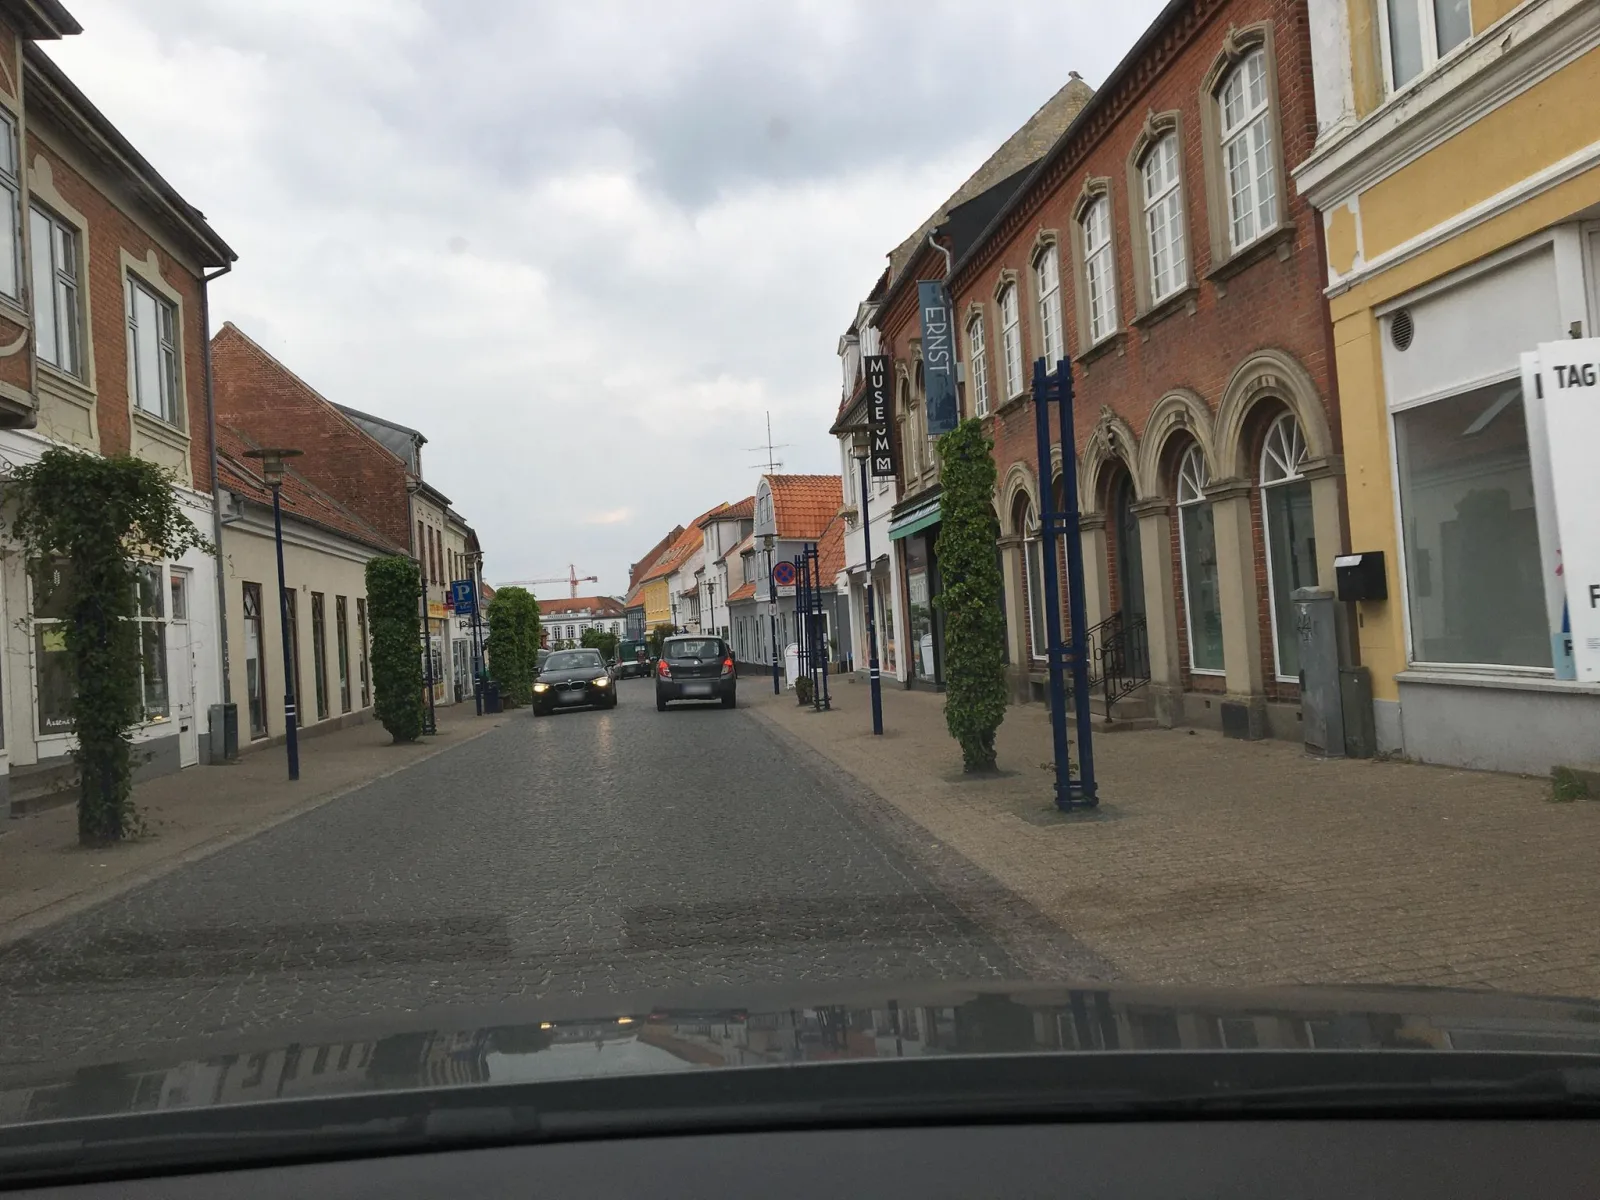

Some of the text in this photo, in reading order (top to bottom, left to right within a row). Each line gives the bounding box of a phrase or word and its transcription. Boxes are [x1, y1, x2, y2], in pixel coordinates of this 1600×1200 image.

[925, 306, 950, 375] ERNST
[870, 358, 889, 451] MUSEUM
[455, 585, 470, 601] P
